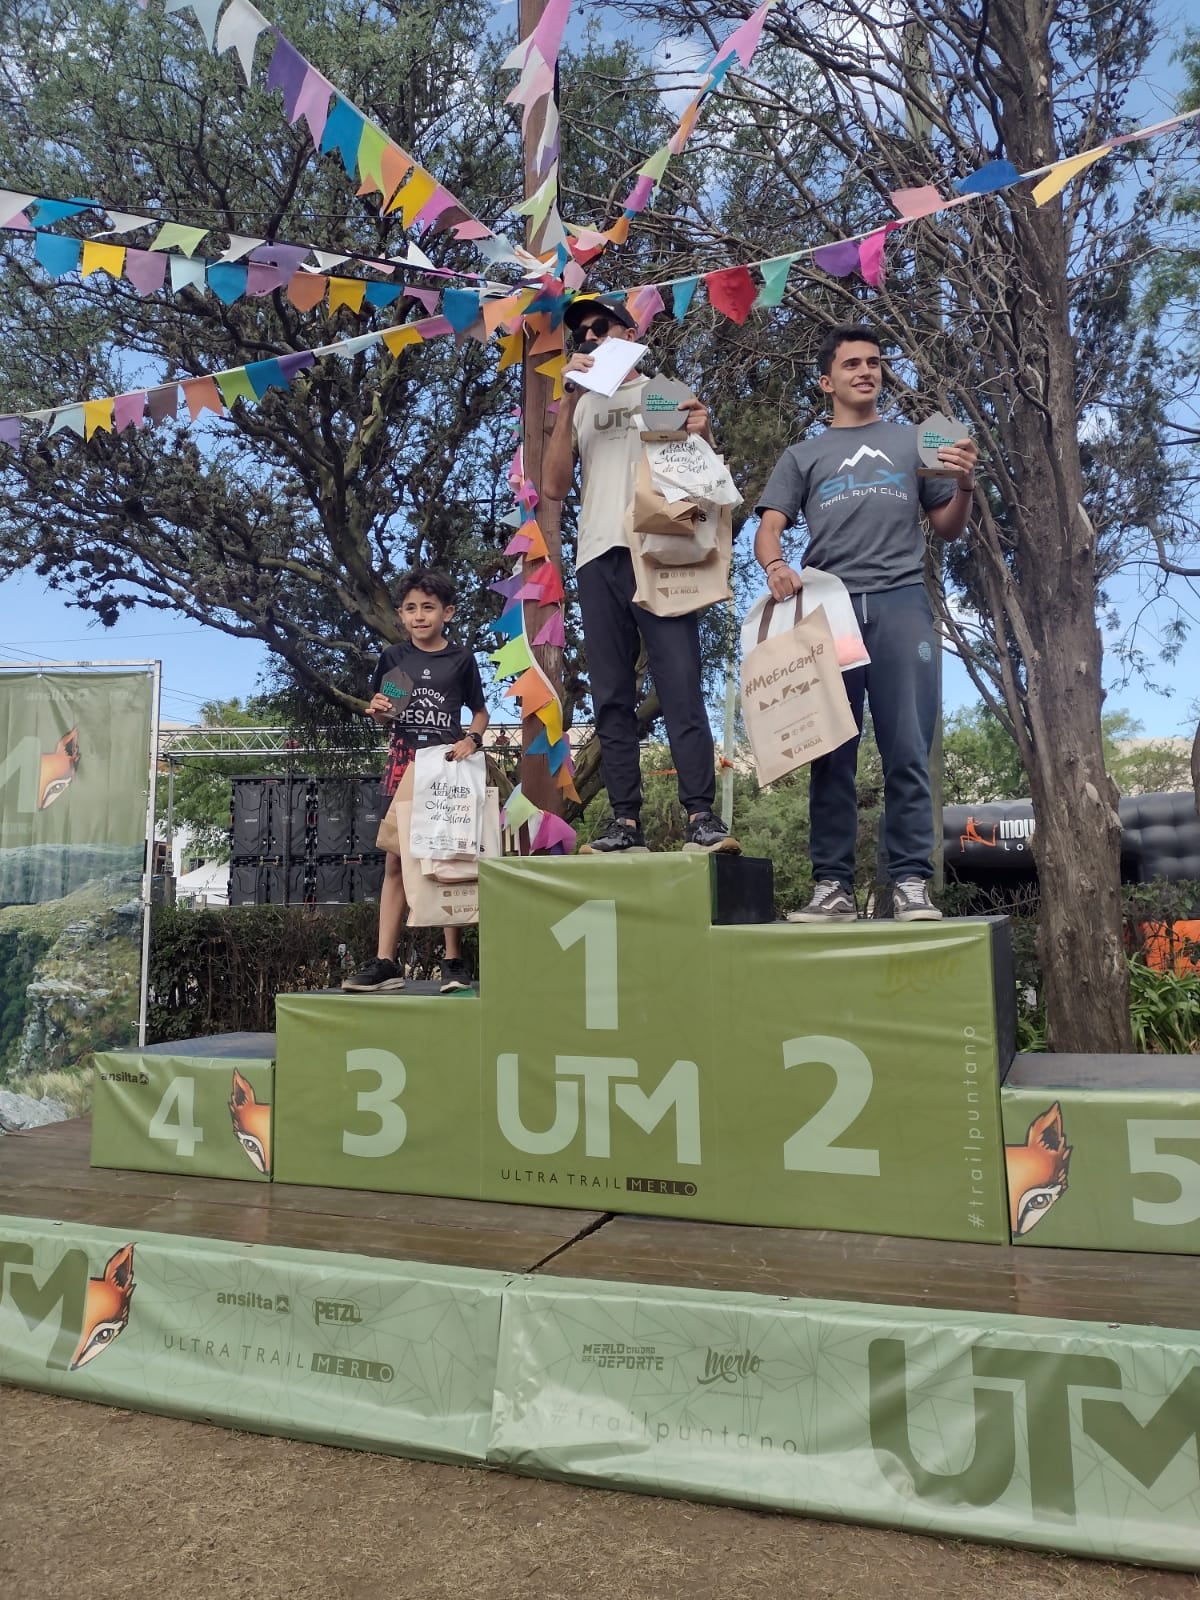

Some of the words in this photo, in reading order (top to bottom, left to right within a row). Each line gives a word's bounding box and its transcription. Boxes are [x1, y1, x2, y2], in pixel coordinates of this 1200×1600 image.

[818, 468, 907, 501] SLX
[820, 494, 849, 510] TRAIL
[852, 487, 877, 497] RUN
[880, 487, 908, 501] CLUB
[745, 643, 824, 697] #MeEncanta
[411, 687, 446, 704] UTDOOR
[550, 899, 619, 1030] 1
[100, 1072, 138, 1084] ansilta
[342, 1047, 408, 1158] 3
[149, 1076, 203, 1157] 4
[496, 1052, 702, 1165] UTM
[782, 1034, 881, 1176] 2
[963, 1024, 985, 1228] #trailpuntano
[501, 1168, 559, 1185] ULTRA
[567, 1174, 621, 1190] TRAIL
[630, 1178, 697, 1196] MERLO
[1127, 1119, 1200, 1226] 5
[216, 1291, 273, 1312] ansilta
[313, 1299, 363, 1327] PETZL
[163, 1334, 231, 1358] ULTRA
[242, 1344, 304, 1369] TRAIL
[316, 1356, 393, 1383] MERLO
[582, 1343, 625, 1354] MERLO
[626, 1346, 656, 1354] CIUDAD
[598, 1355, 665, 1371] DEPORTE
[696, 1348, 764, 1385] Merlo
[551, 1402, 798, 1456] #trailpuntano
[868, 1337, 1200, 1527] UTM
